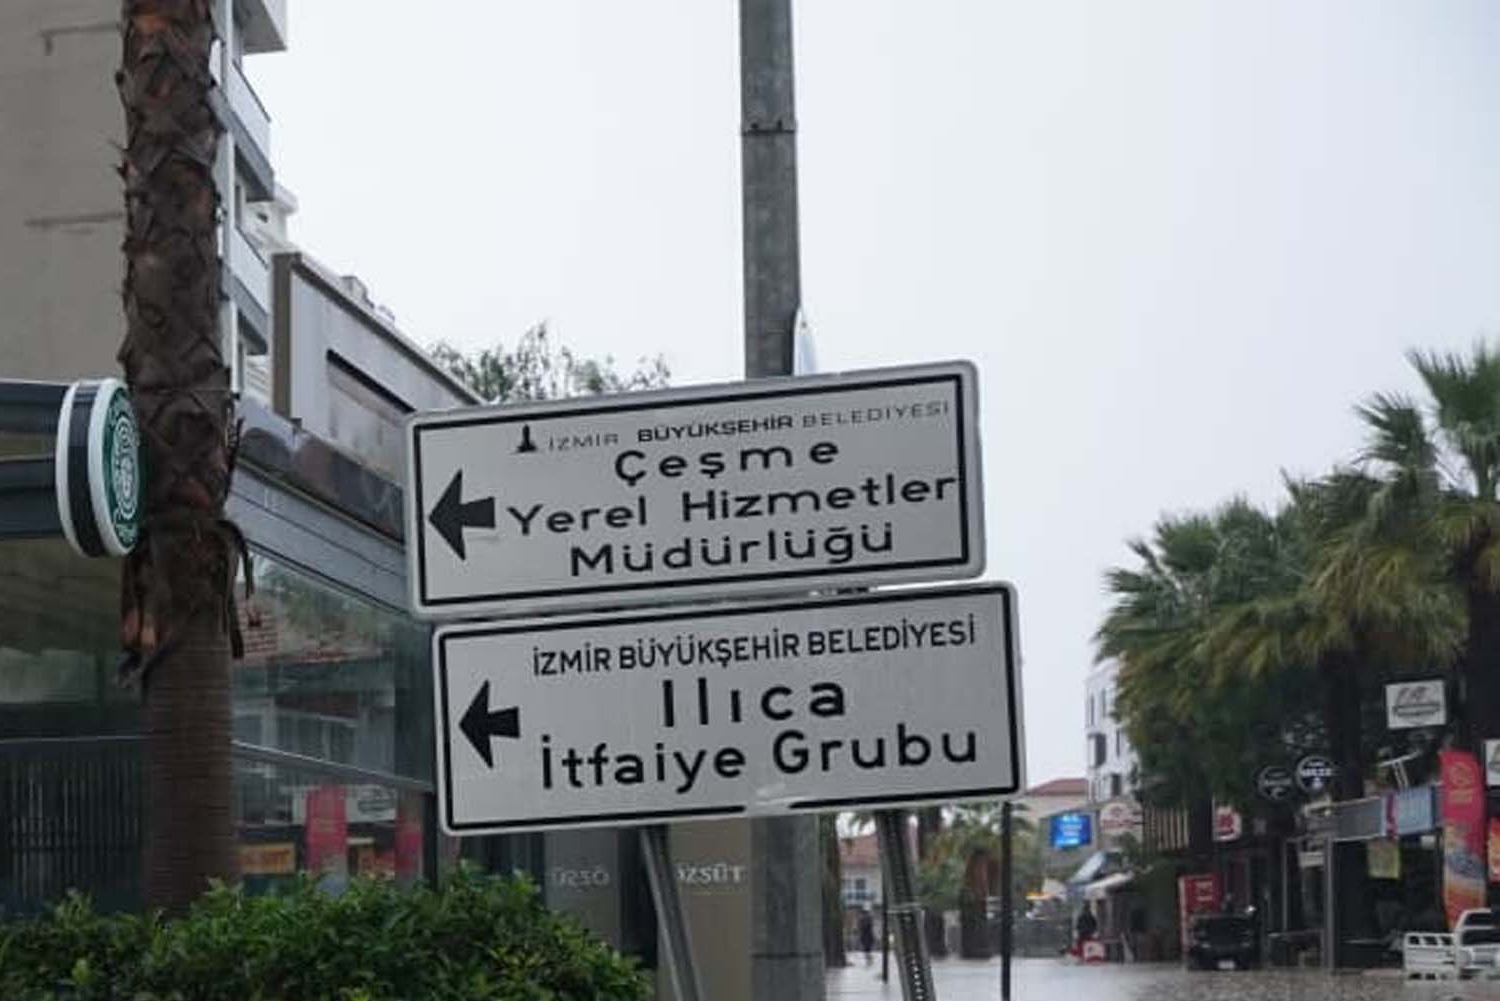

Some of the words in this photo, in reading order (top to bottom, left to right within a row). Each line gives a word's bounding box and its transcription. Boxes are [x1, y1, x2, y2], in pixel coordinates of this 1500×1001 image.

[614, 440, 840, 487] Çeşme
[506, 495, 647, 536] Yerel
[681, 473, 957, 522] Hizmetler
[570, 522, 893, 576] Müdürlüğü
[532, 646, 611, 676] İZMİR
[618, 628, 801, 670] BÜYÜKŞEHİR
[807, 613, 976, 656] BELEDİYESİ
[661, 677, 846, 728] Ilıca
[541, 734, 747, 794] İtfaiye
[772, 723, 977, 774] Grubu
